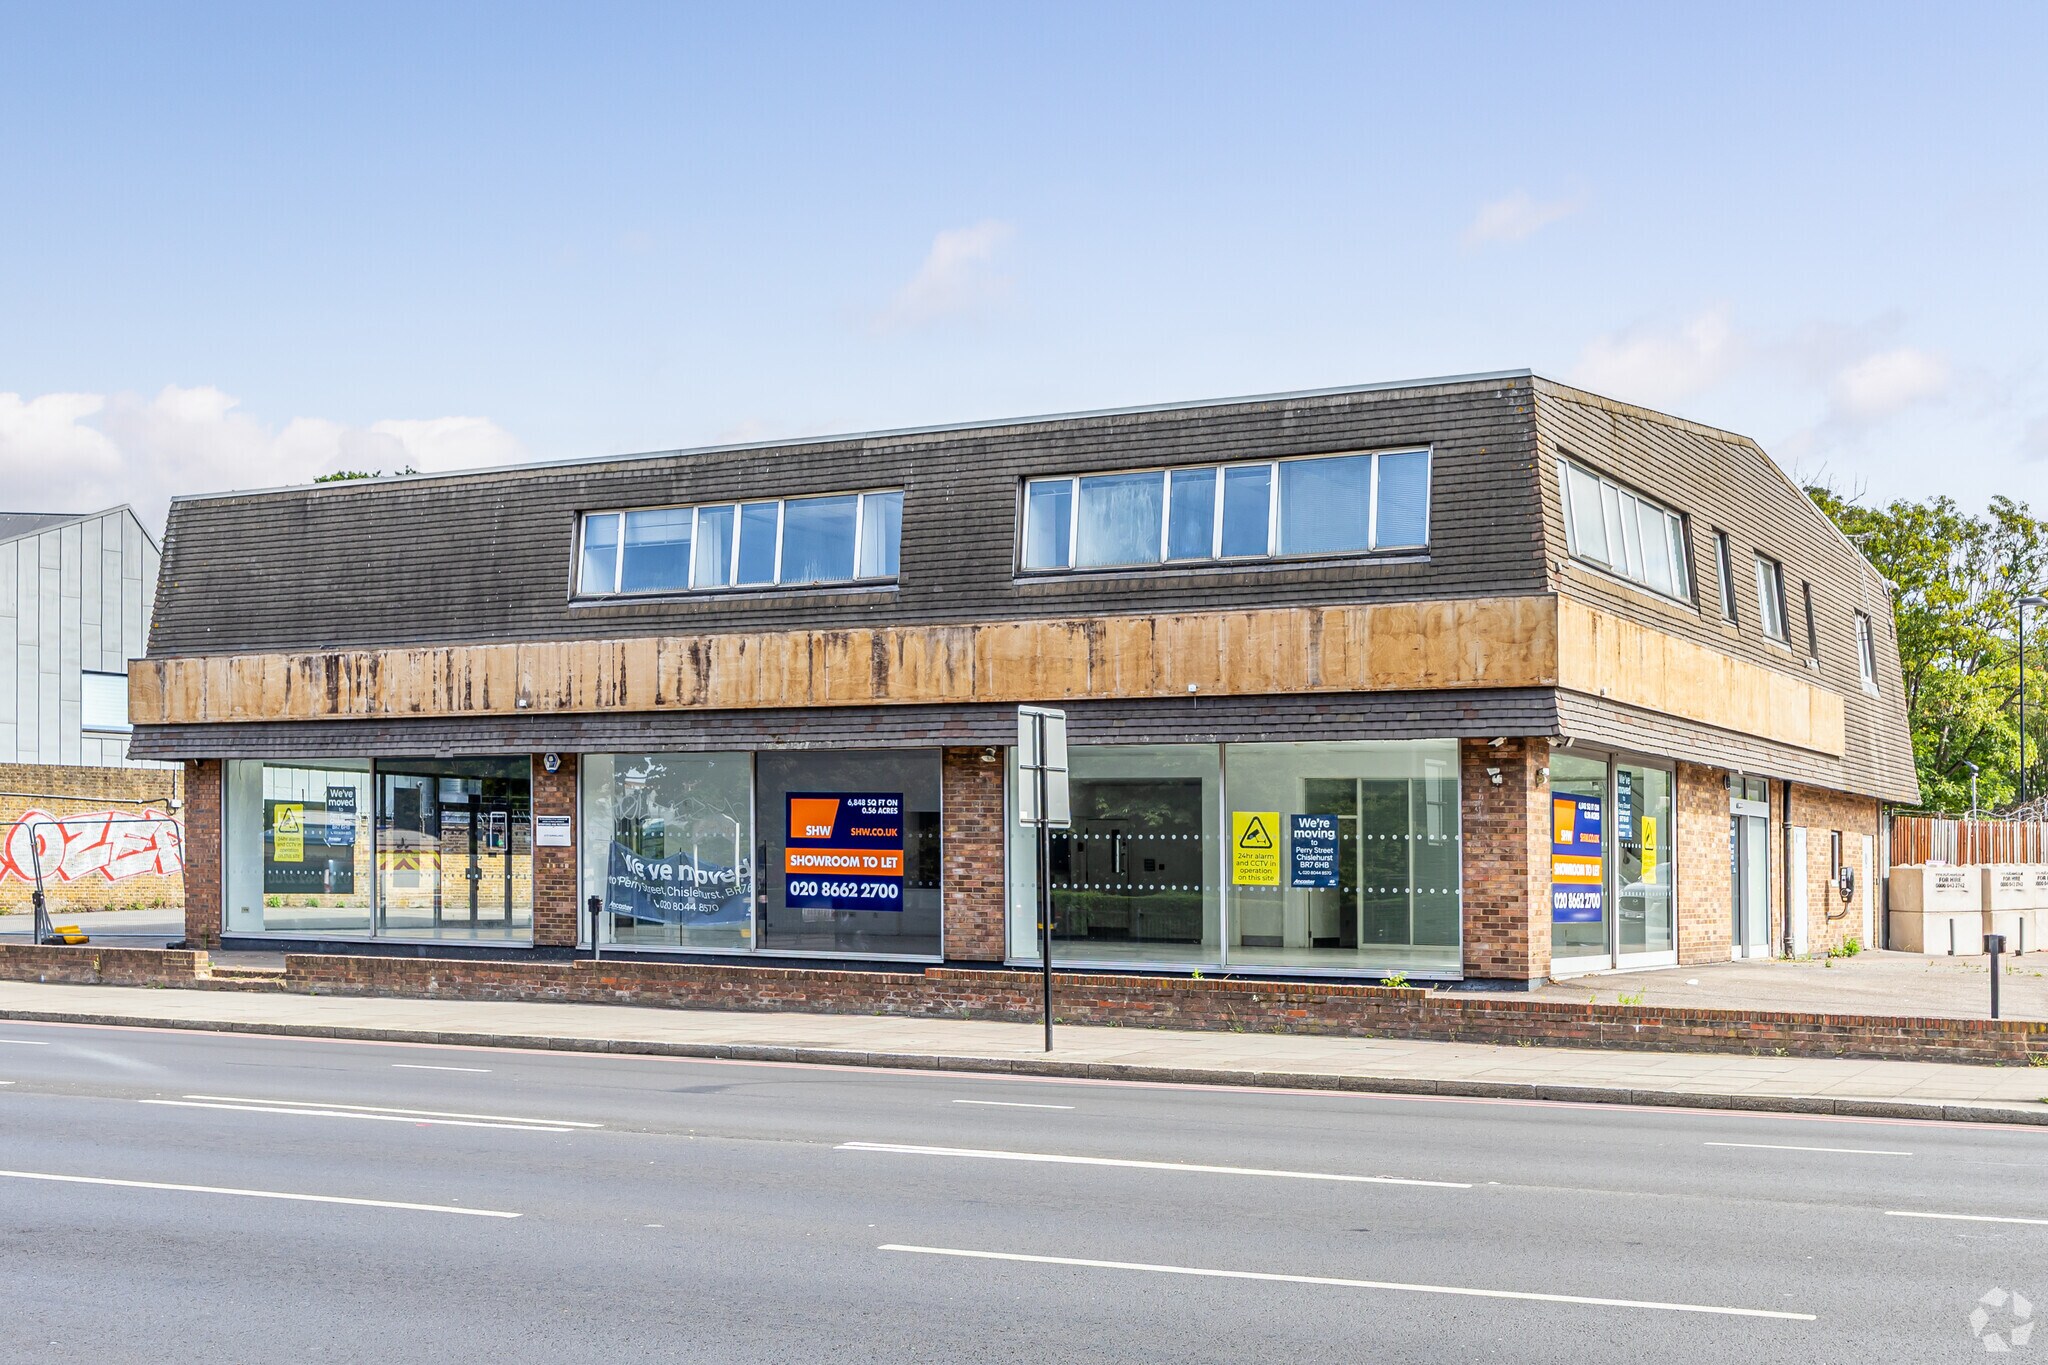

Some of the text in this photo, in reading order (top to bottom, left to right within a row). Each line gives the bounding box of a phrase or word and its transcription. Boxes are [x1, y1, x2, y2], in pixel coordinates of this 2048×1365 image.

[330, 788, 354, 798] We've
[328, 798, 355, 807] moved
[848, 799, 865, 807] 6,848
[1299, 818, 1330, 828] We're
[806, 825, 831, 836] SHW
[851, 827, 898, 837] SHW.CO.UK
[1294, 828, 1336, 840] moving
[790, 855, 898, 868] SHOWROOM TO LET
[667, 886, 725, 900] Chislehurst,
[790, 881, 898, 899] 020 8662 2700
[660, 900, 720, 912] 020 8044 8570
[1554, 892, 1601, 909] 020 8662 2700
